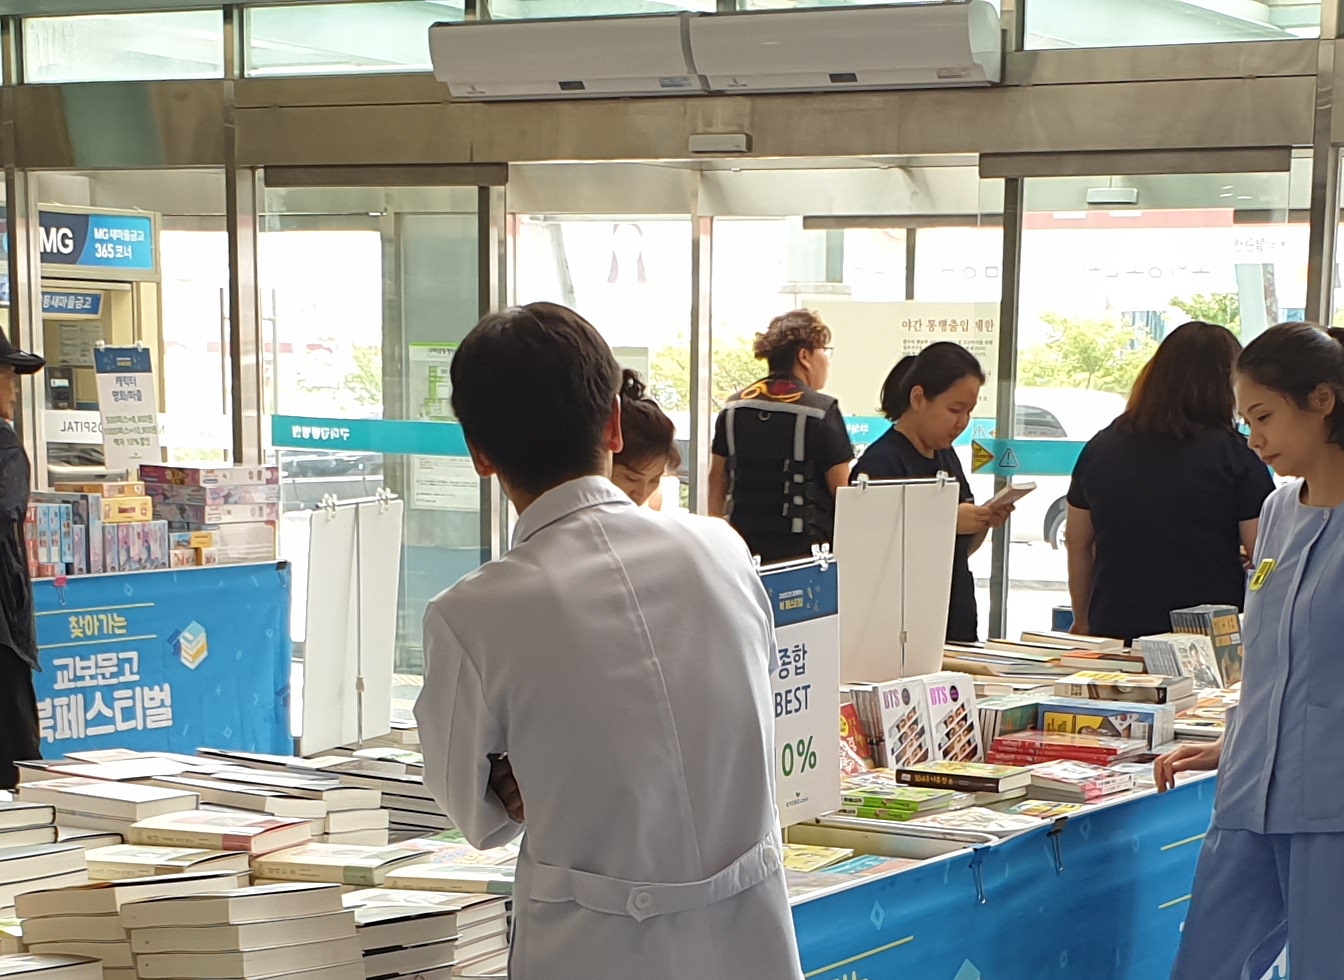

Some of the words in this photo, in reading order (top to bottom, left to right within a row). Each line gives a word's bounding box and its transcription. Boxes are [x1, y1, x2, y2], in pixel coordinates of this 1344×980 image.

[40, 227, 74, 254] MG
[94, 228, 109, 241] MG
[94, 244, 114, 259] 365
[115, 245, 133, 259] 코너
[901, 317, 923, 333] 야간
[926, 317, 970, 334] 통행출입
[69, 612, 128, 640] 찾아가는
[52, 650, 140, 691] 교보문고
[778, 643, 808, 680] 종합
[775, 684, 811, 718] BEST
[883, 690, 900, 710] BTS
[929, 686, 948, 705] BTS
